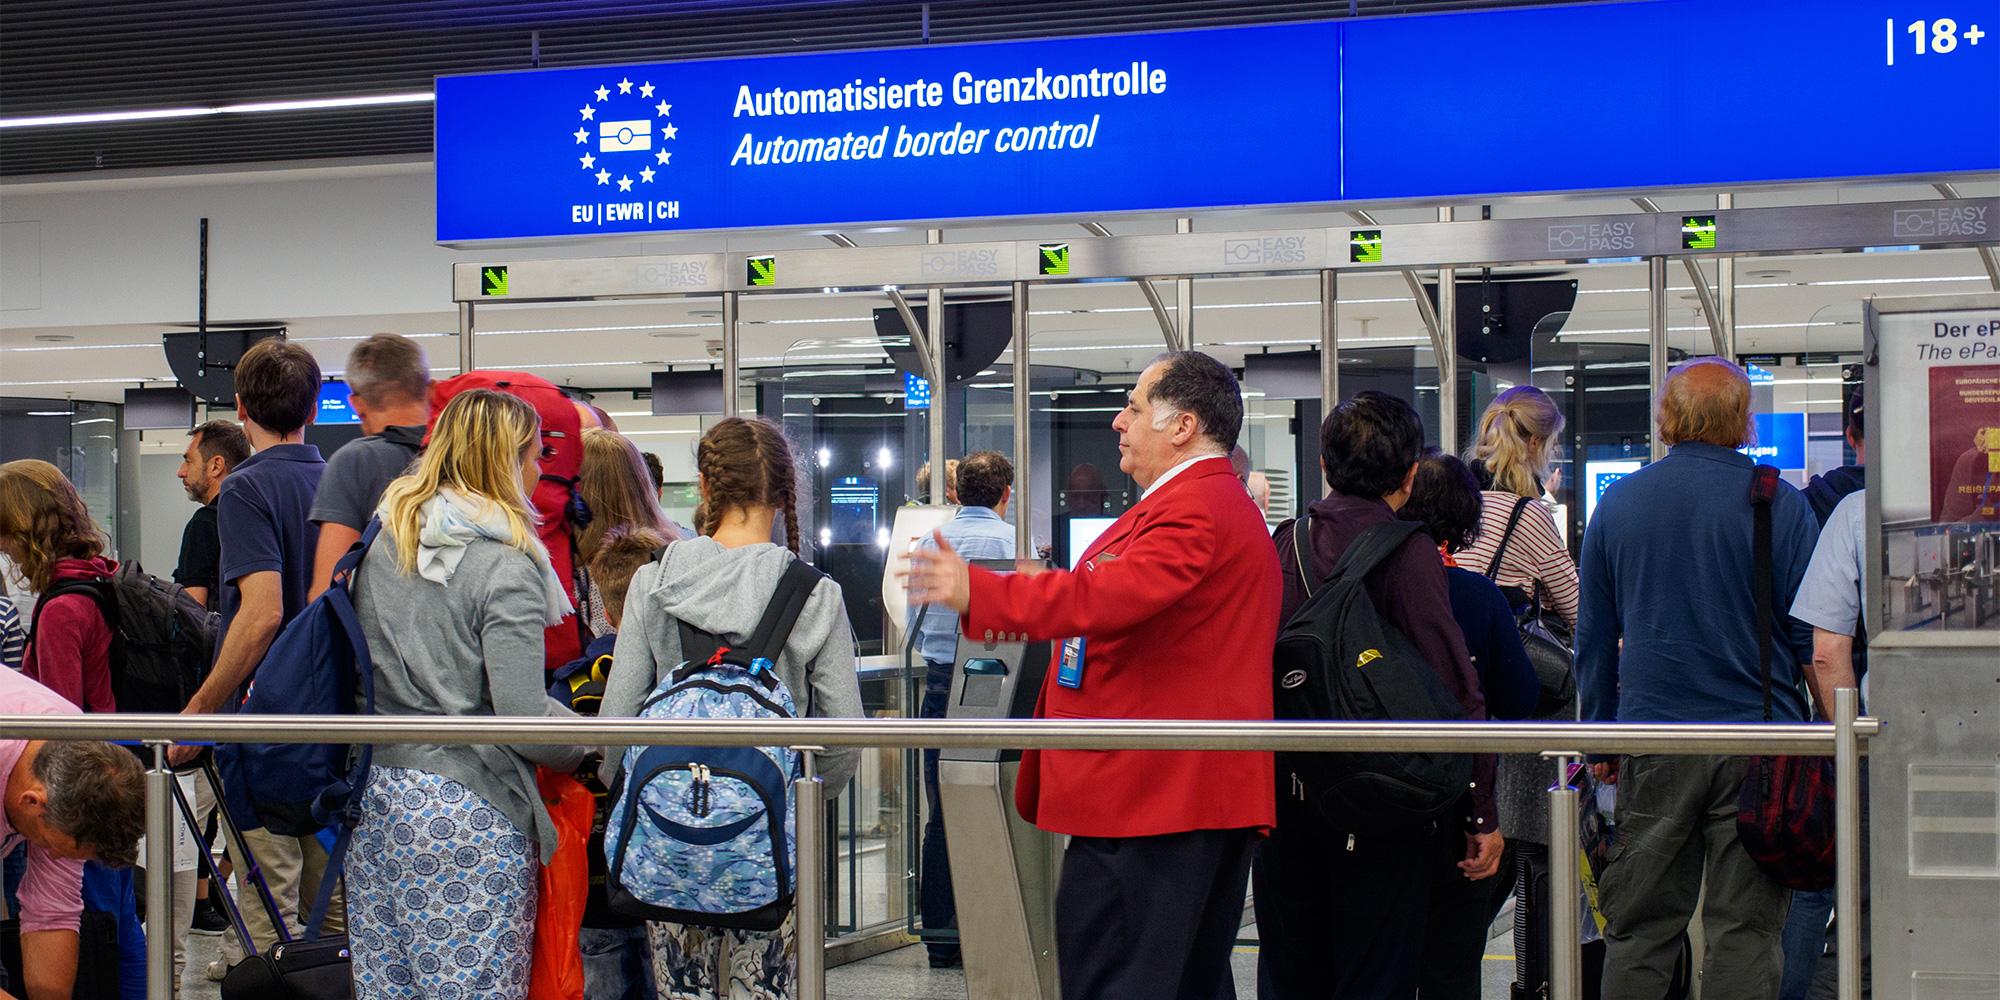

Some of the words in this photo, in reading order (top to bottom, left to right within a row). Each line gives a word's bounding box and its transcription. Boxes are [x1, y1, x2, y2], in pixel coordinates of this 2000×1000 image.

[1907, 18, 1986, 55] 18+
[733, 77, 943, 118] Automatisierte
[952, 61, 1167, 106] Grenzkontrolle
[730, 125, 889, 166] Automated
[893, 121, 990, 158] border
[994, 114, 1100, 153] control
[572, 204, 594, 223] EU
[606, 202, 644, 221] EWR
[656, 200, 680, 219] CH
[1938, 206, 1988, 221] EASY
[1589, 222, 1635, 237] EASY
[1938, 221, 1987, 236] PASS
[1263, 236, 1306, 251] EASY
[1589, 235, 1635, 251] PASS
[958, 249, 999, 263] EASY
[1263, 249, 1306, 264] PASS
[669, 261, 708, 274] EASY
[957, 262, 998, 276] PASS
[669, 274, 708, 287] PASS
[1934, 322, 1970, 338] Der
[1917, 344, 1952, 360] The
[1959, 342, 2000, 359] ePa
